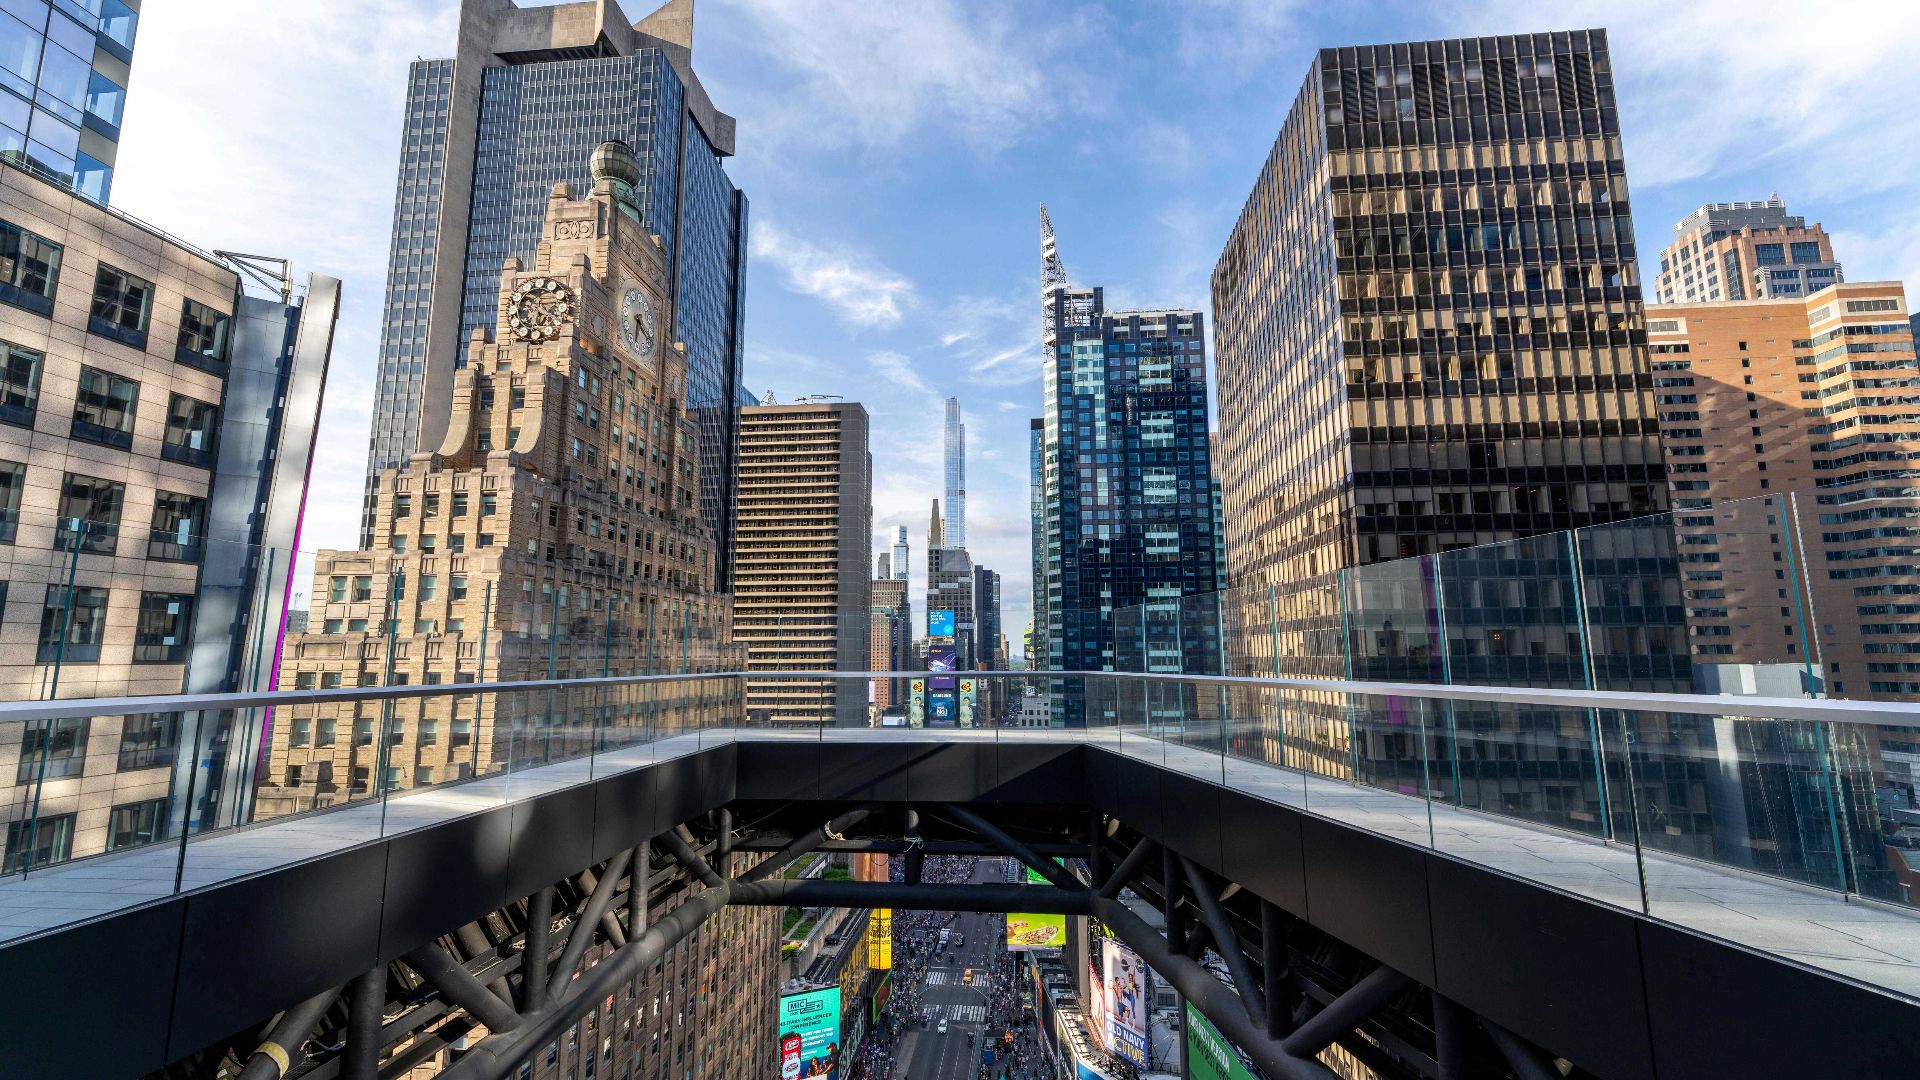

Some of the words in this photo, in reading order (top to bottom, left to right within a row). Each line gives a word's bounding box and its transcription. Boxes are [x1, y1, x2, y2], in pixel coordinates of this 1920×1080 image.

[789, 1020, 822, 1030] CONFERENCE
[1107, 1021, 1121, 1036] OLD
[1123, 1031, 1144, 1049] NAVY
[1108, 1034, 1144, 1062] ACTIVE
